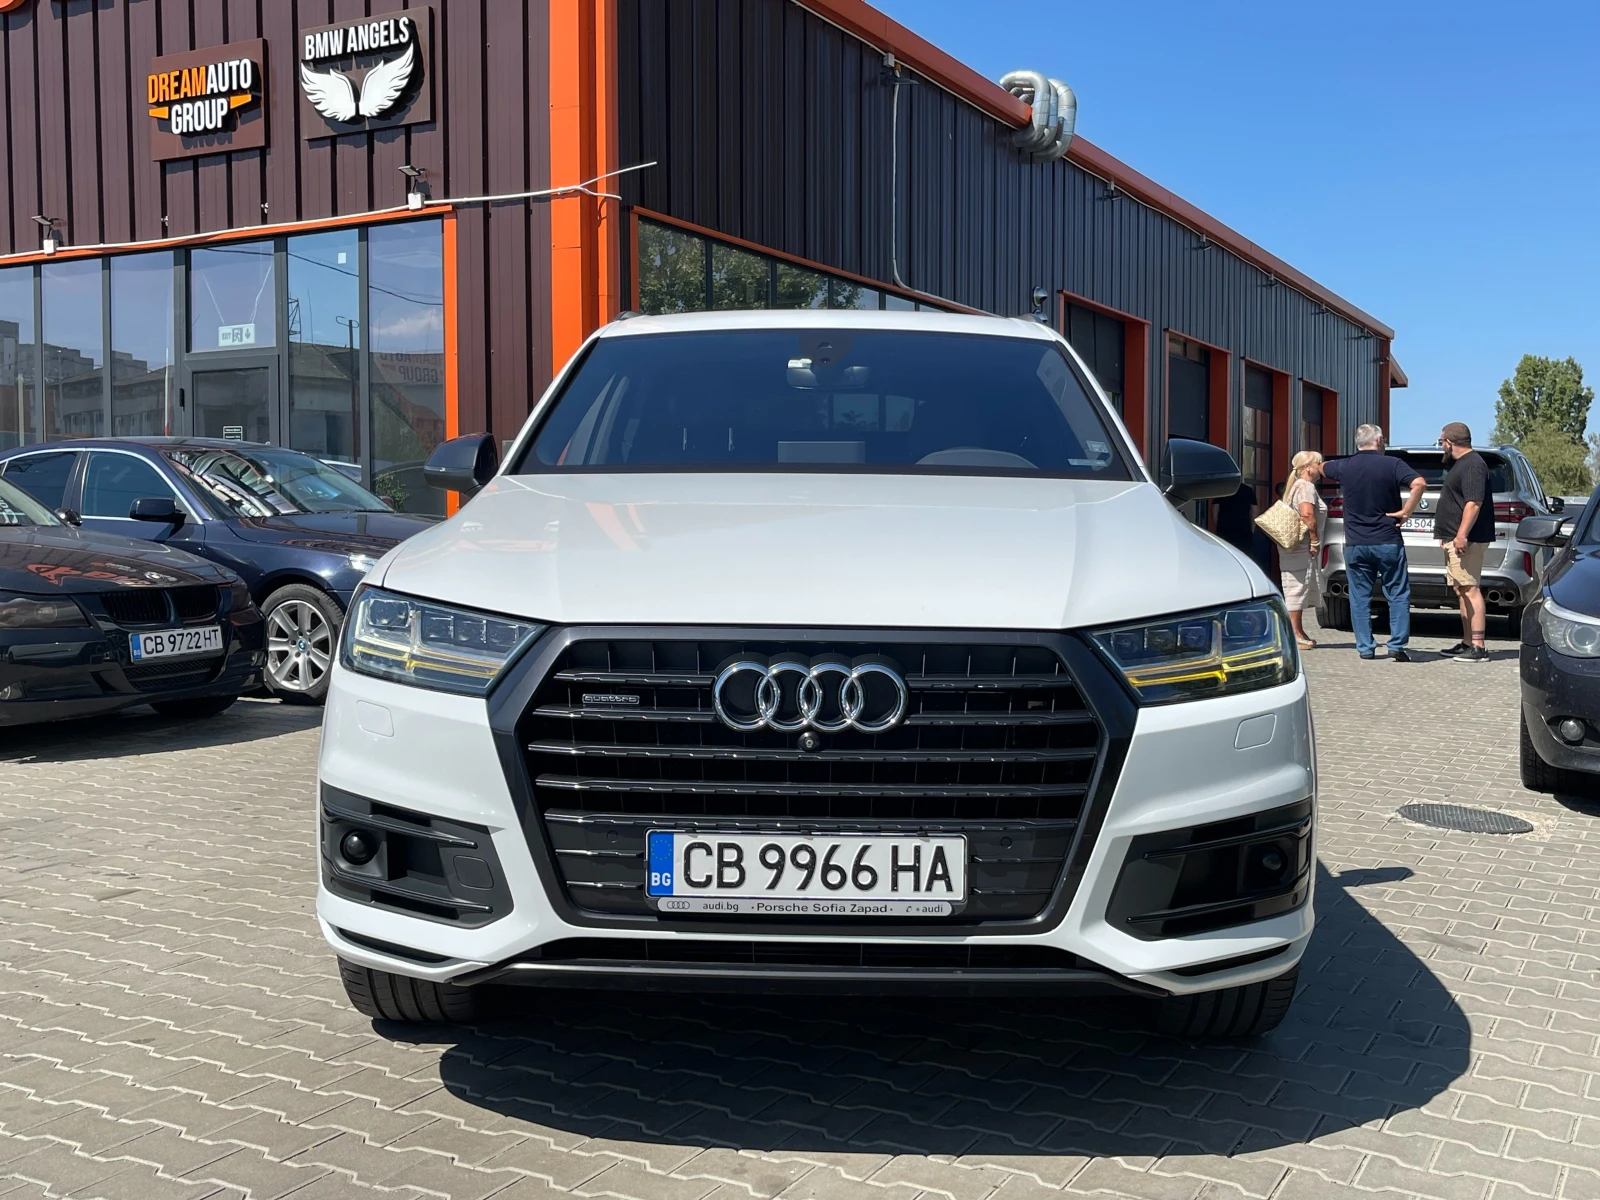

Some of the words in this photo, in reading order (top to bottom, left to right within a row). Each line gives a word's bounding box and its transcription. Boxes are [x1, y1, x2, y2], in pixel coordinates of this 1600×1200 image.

[305, 28, 345, 61] BMW
[348, 16, 410, 54] ANGELS
[171, 98, 228, 135] GROUP
[143, 635, 165, 655] CB
[168, 631, 202, 653] 9722
[203, 628, 219, 648] HT
[584, 695, 638, 703] quattro
[651, 872, 672, 887] BG
[682, 841, 746, 889] CB
[758, 843, 879, 891] 9966
[889, 844, 954, 893] HA
[702, 901, 739, 913] audi.bg
[756, 902, 809, 913] Porsche
[812, 903, 846, 913] Sofia
[850, 903, 888, 914] Zapad
